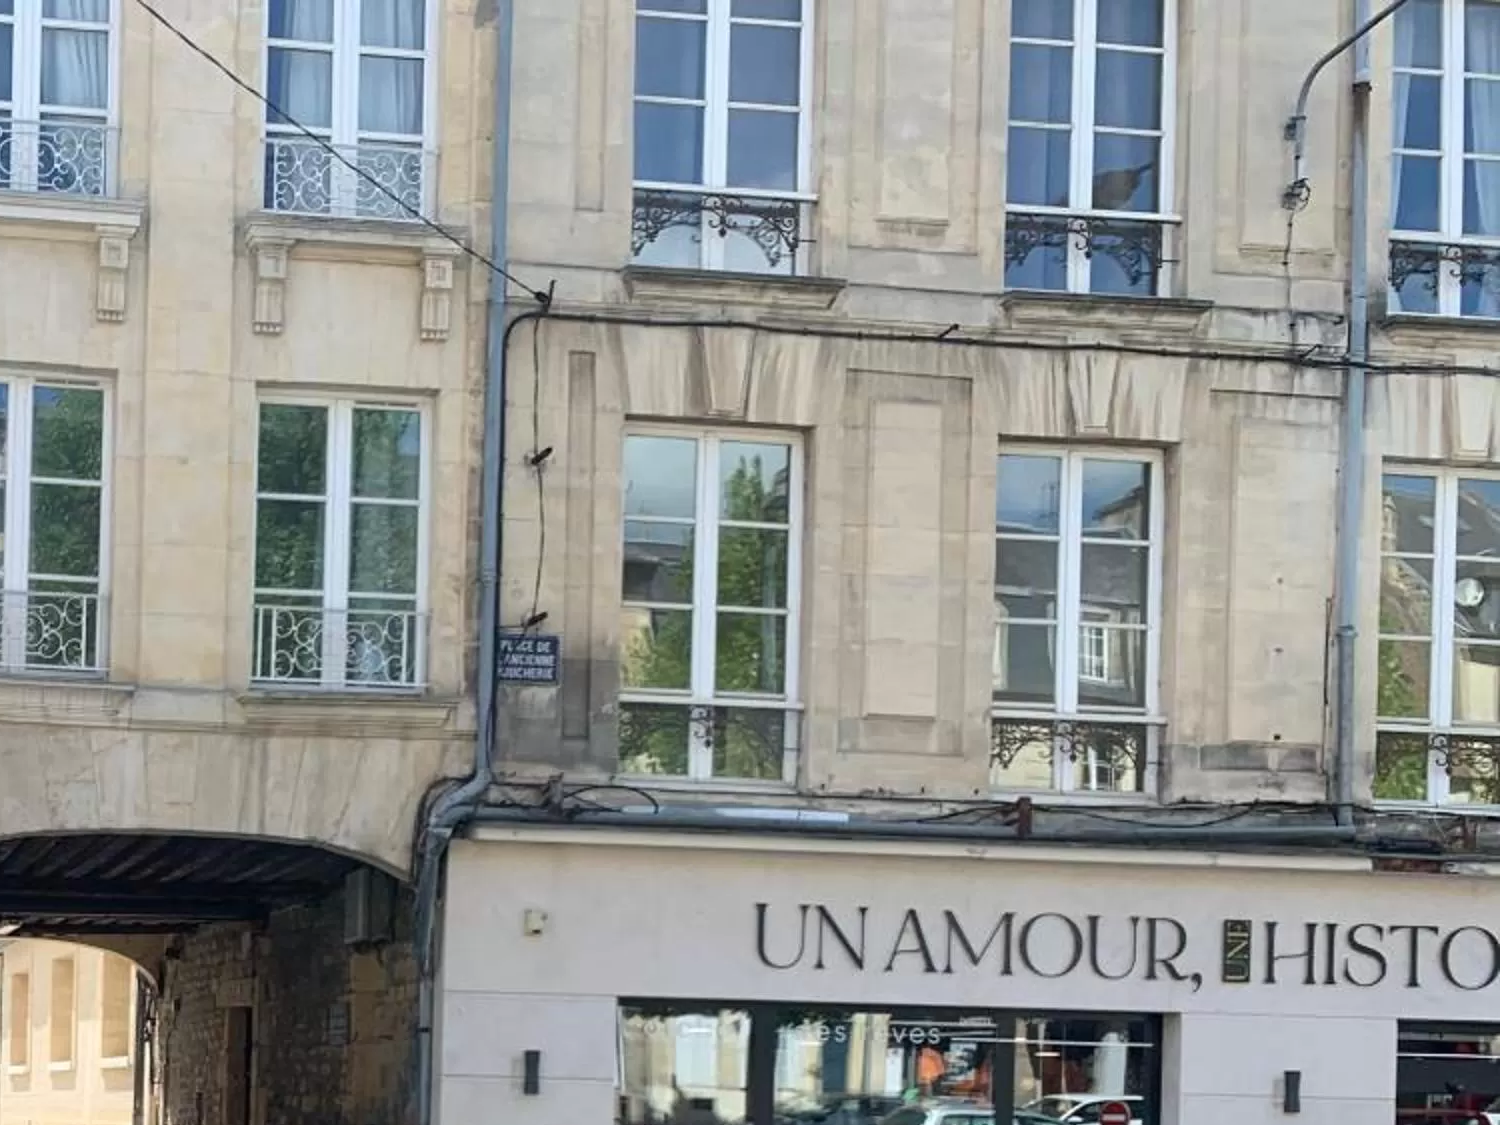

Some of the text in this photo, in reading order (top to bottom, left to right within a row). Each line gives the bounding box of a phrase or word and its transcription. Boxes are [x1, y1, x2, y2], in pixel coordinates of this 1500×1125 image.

[537, 641, 551, 653] DE
[499, 654, 555, 667] ANCIENNE
[755, 902, 1500, 993] UN AMOUR, UNE HISTO
